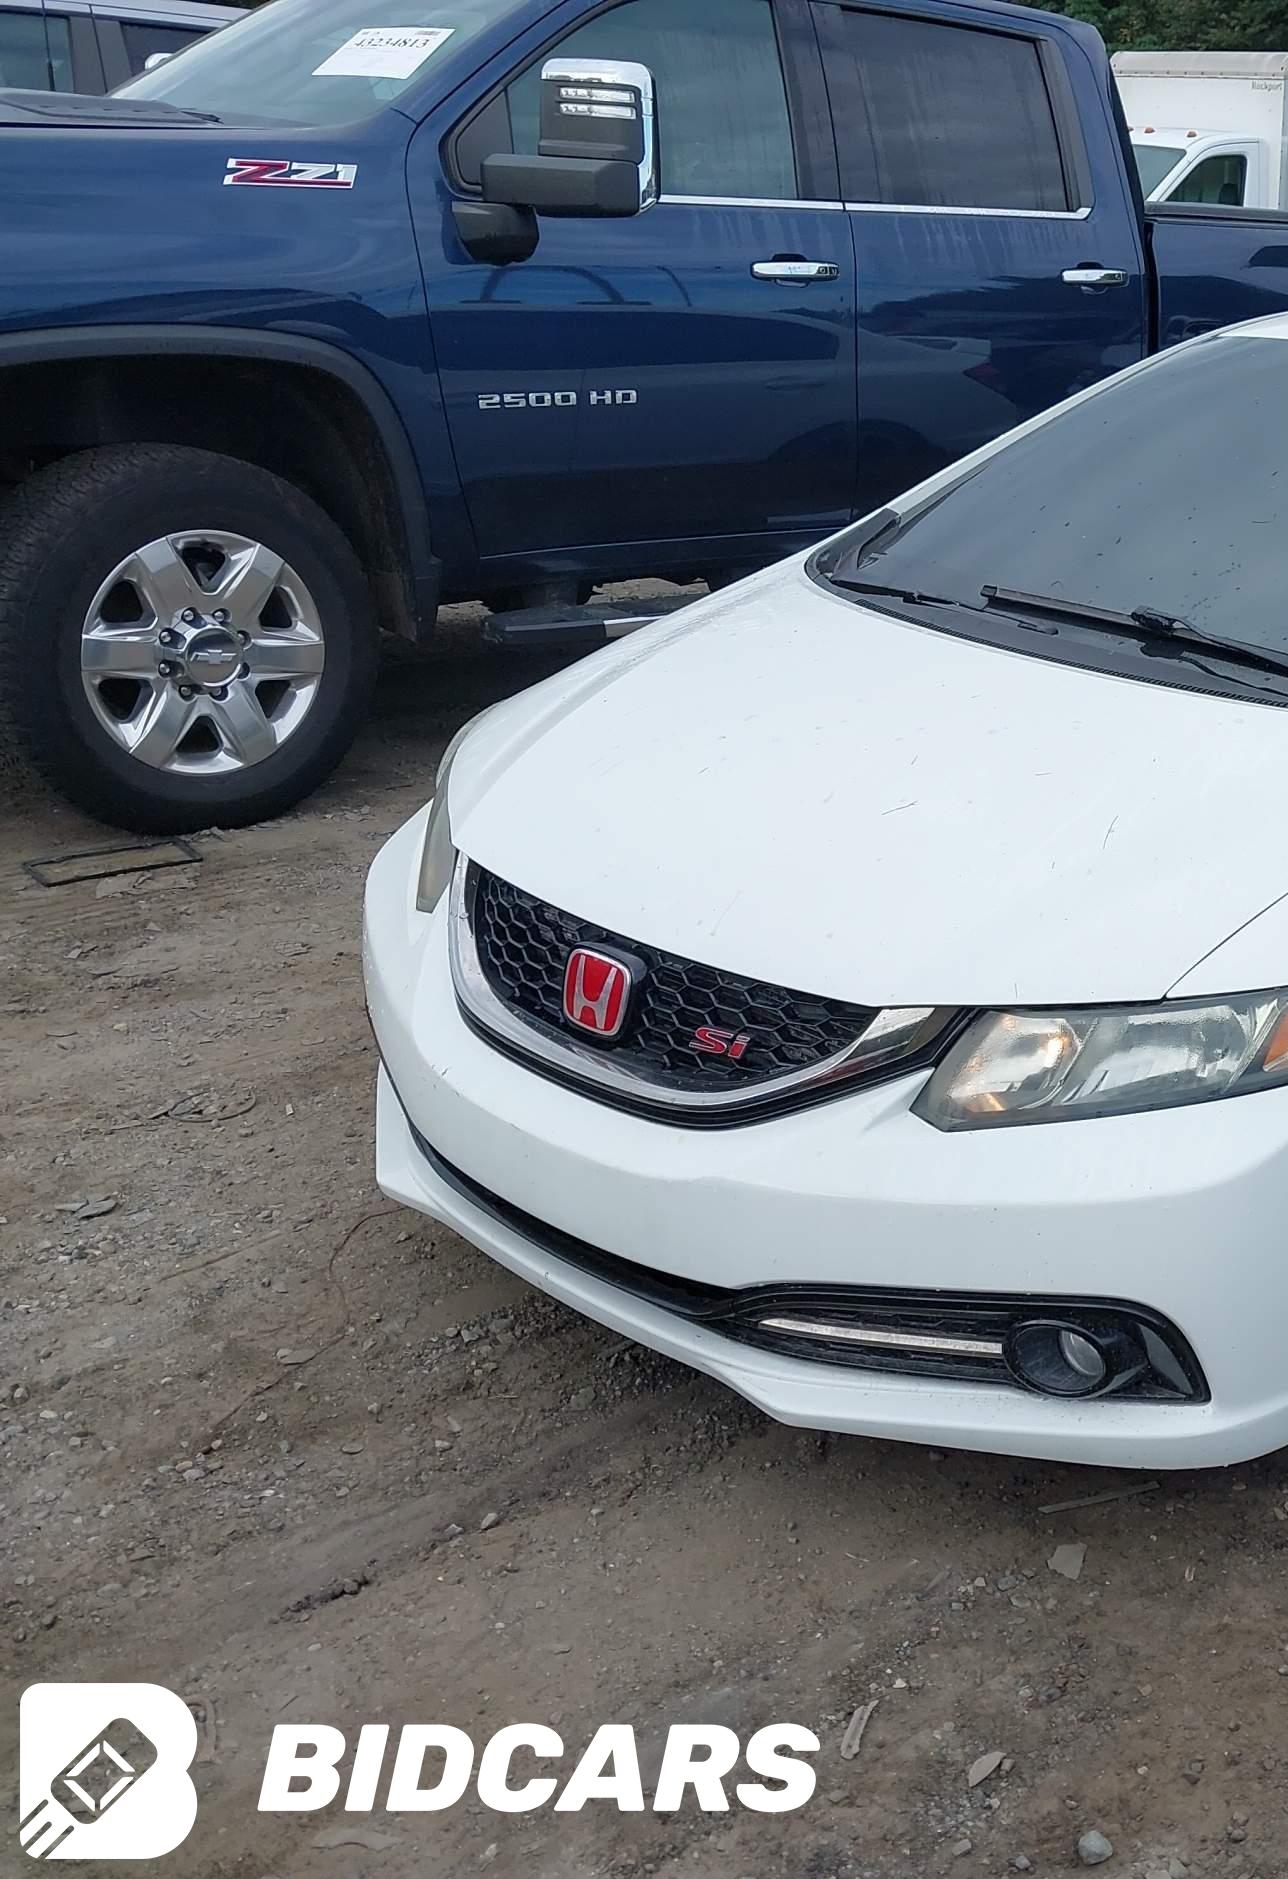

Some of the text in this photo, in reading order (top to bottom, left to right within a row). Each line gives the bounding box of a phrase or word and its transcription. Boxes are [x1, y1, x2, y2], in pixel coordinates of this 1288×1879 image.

[354, 38, 430, 48] 43234813
[223, 158, 358, 189] Z71
[478, 389, 638, 410] 2500 HD
[688, 1026, 751, 1060] Si
